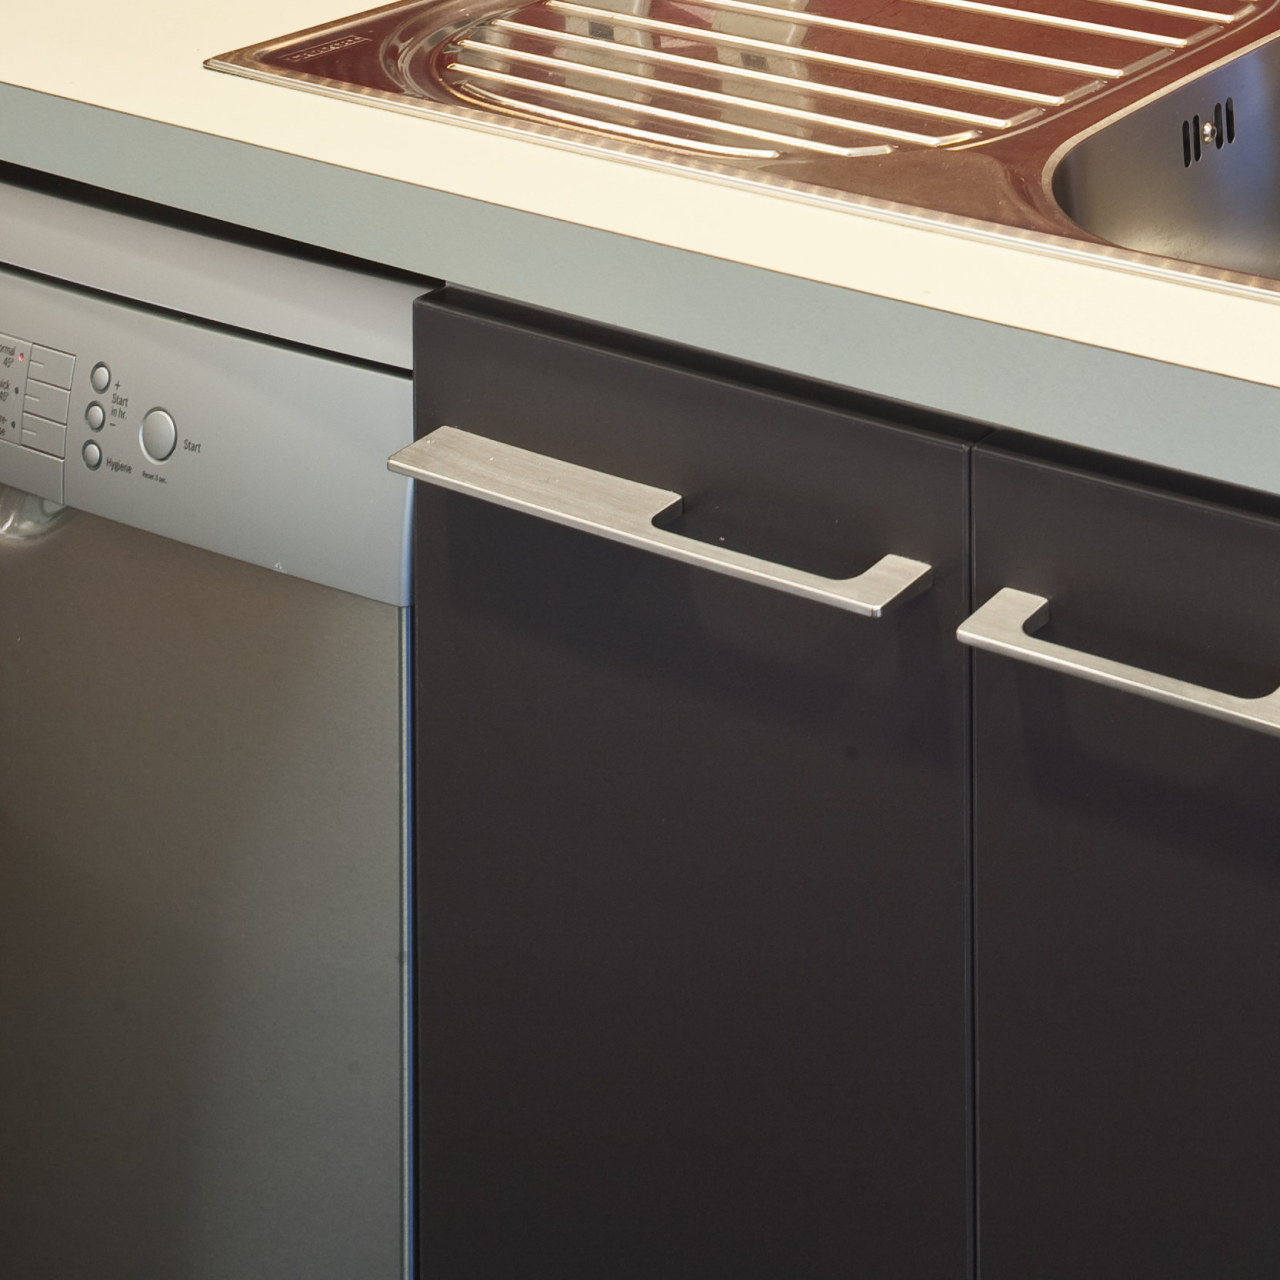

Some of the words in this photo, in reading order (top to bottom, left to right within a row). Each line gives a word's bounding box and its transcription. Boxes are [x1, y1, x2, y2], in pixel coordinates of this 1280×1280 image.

[111, 393, 129, 408] Start
[111, 408, 118, 417] in
[118, 408, 127, 420] hr.
[183, 438, 202, 453] Start
[105, 456, 133, 474] Hygiene
